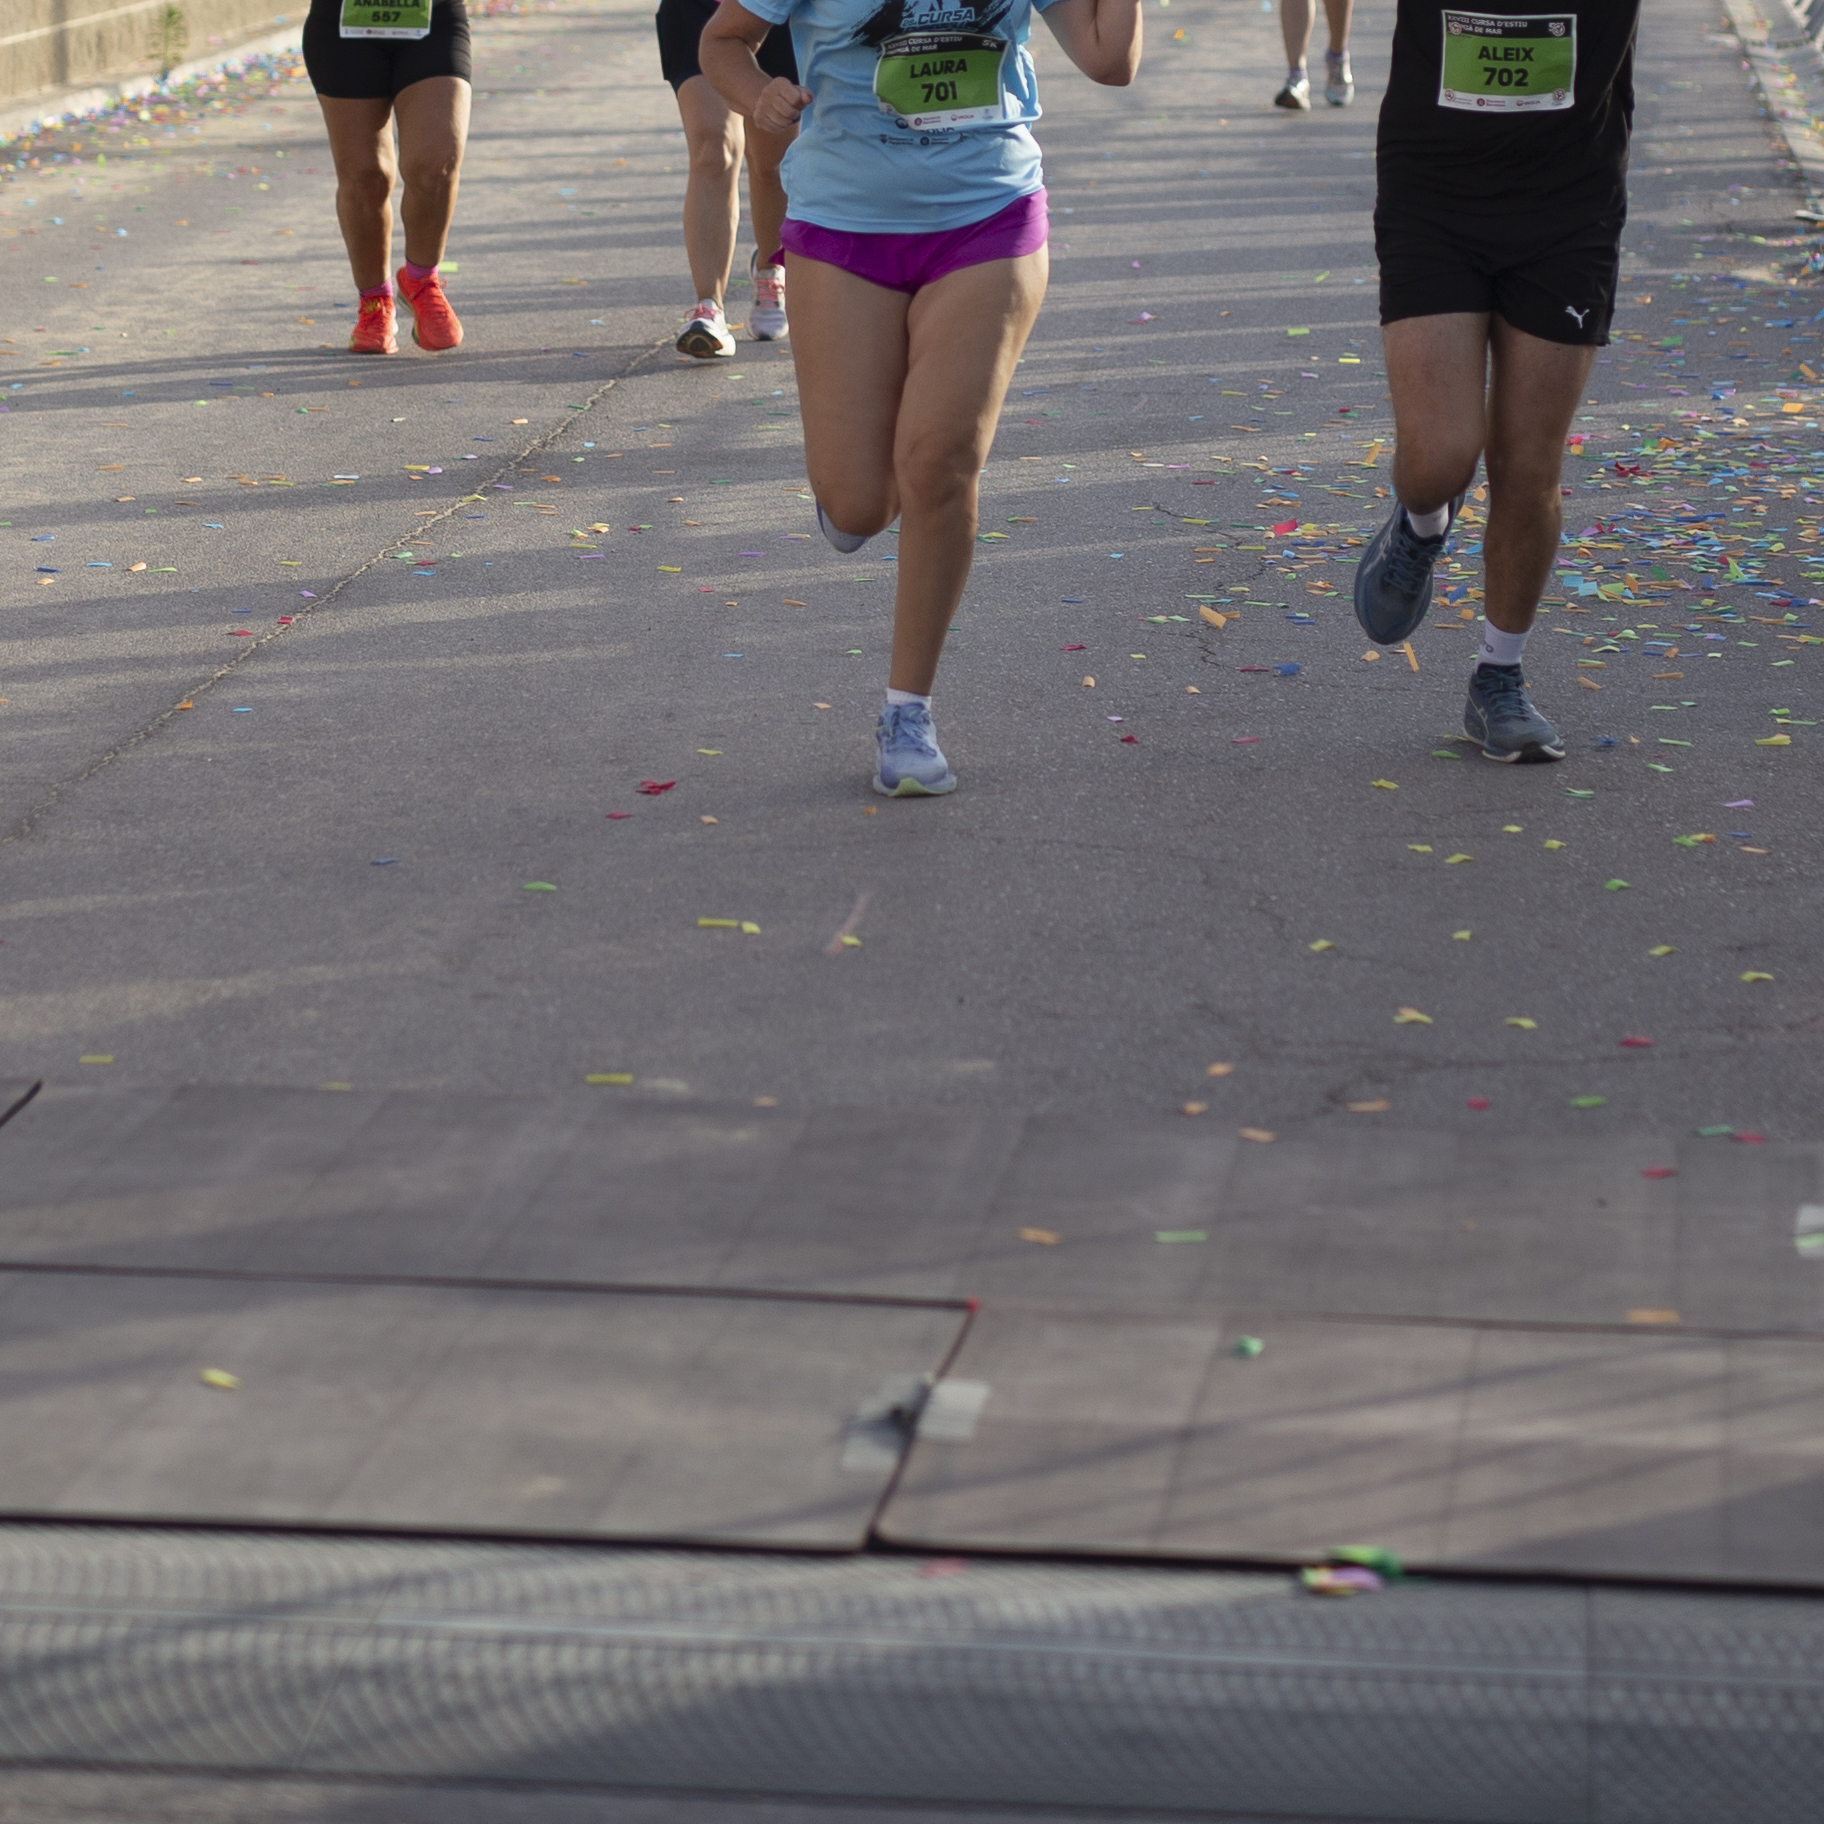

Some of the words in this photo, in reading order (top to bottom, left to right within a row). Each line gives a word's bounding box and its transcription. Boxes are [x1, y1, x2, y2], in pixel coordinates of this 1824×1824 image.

[371, 11, 402, 23] 557
[917, 8, 973, 25] CURSA
[981, 39, 998, 49] 5K
[1477, 45, 1535, 62] ALEIX
[910, 58, 968, 79] LAURA
[1483, 66, 1529, 87] 702
[921, 80, 958, 103] 701
